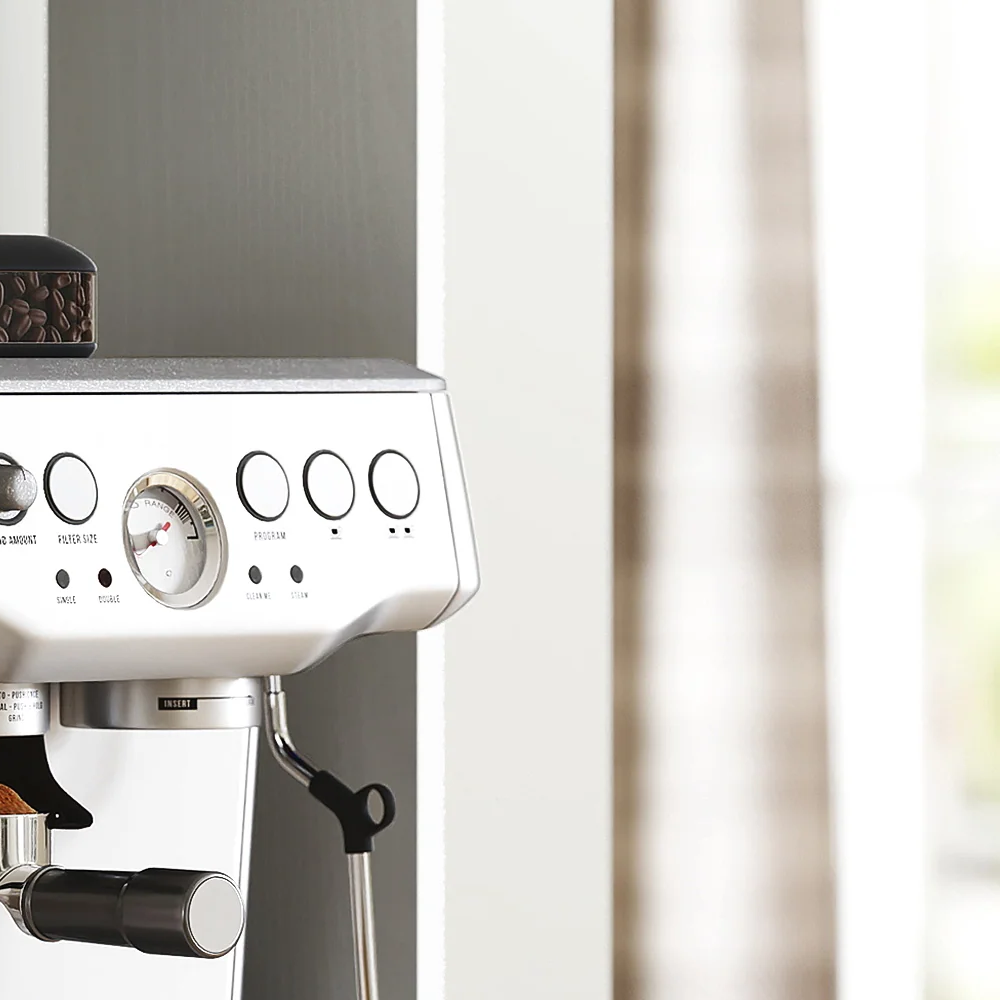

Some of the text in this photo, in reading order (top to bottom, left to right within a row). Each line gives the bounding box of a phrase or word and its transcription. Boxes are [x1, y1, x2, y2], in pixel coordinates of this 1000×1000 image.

[144, 499, 176, 518] RANGE
[8, 534, 37, 545] AMOUNT
[57, 533, 98, 545] FILTER SIZE
[253, 531, 286, 541] PROGRAM
[98, 594, 120, 604] DOUBLE
[163, 699, 191, 708] INSERT
